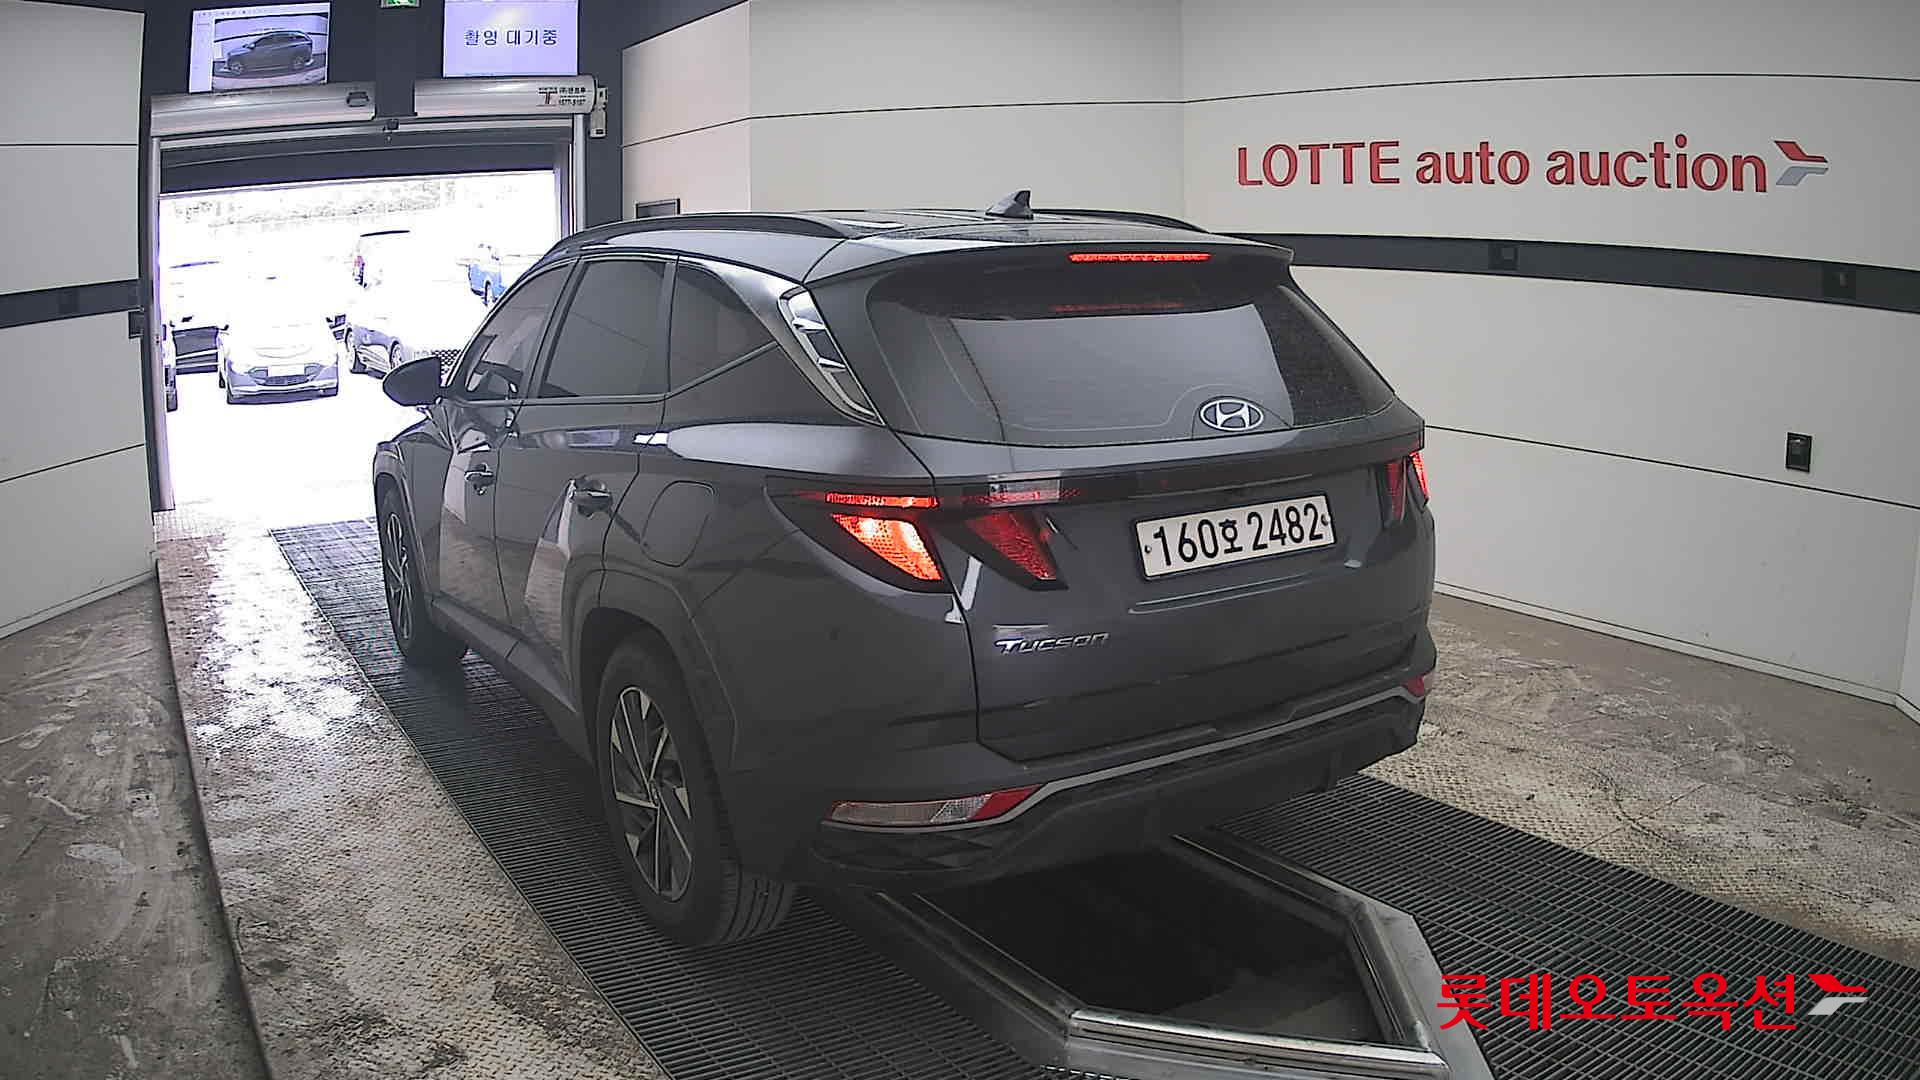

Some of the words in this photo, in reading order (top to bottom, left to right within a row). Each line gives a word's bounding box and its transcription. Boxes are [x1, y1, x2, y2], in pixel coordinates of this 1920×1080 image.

[506, 28, 558, 46] 대기중
[1236, 140, 1400, 187] LOTTE
[1415, 141, 1531, 186] auto
[1545, 134, 1768, 192] auction
